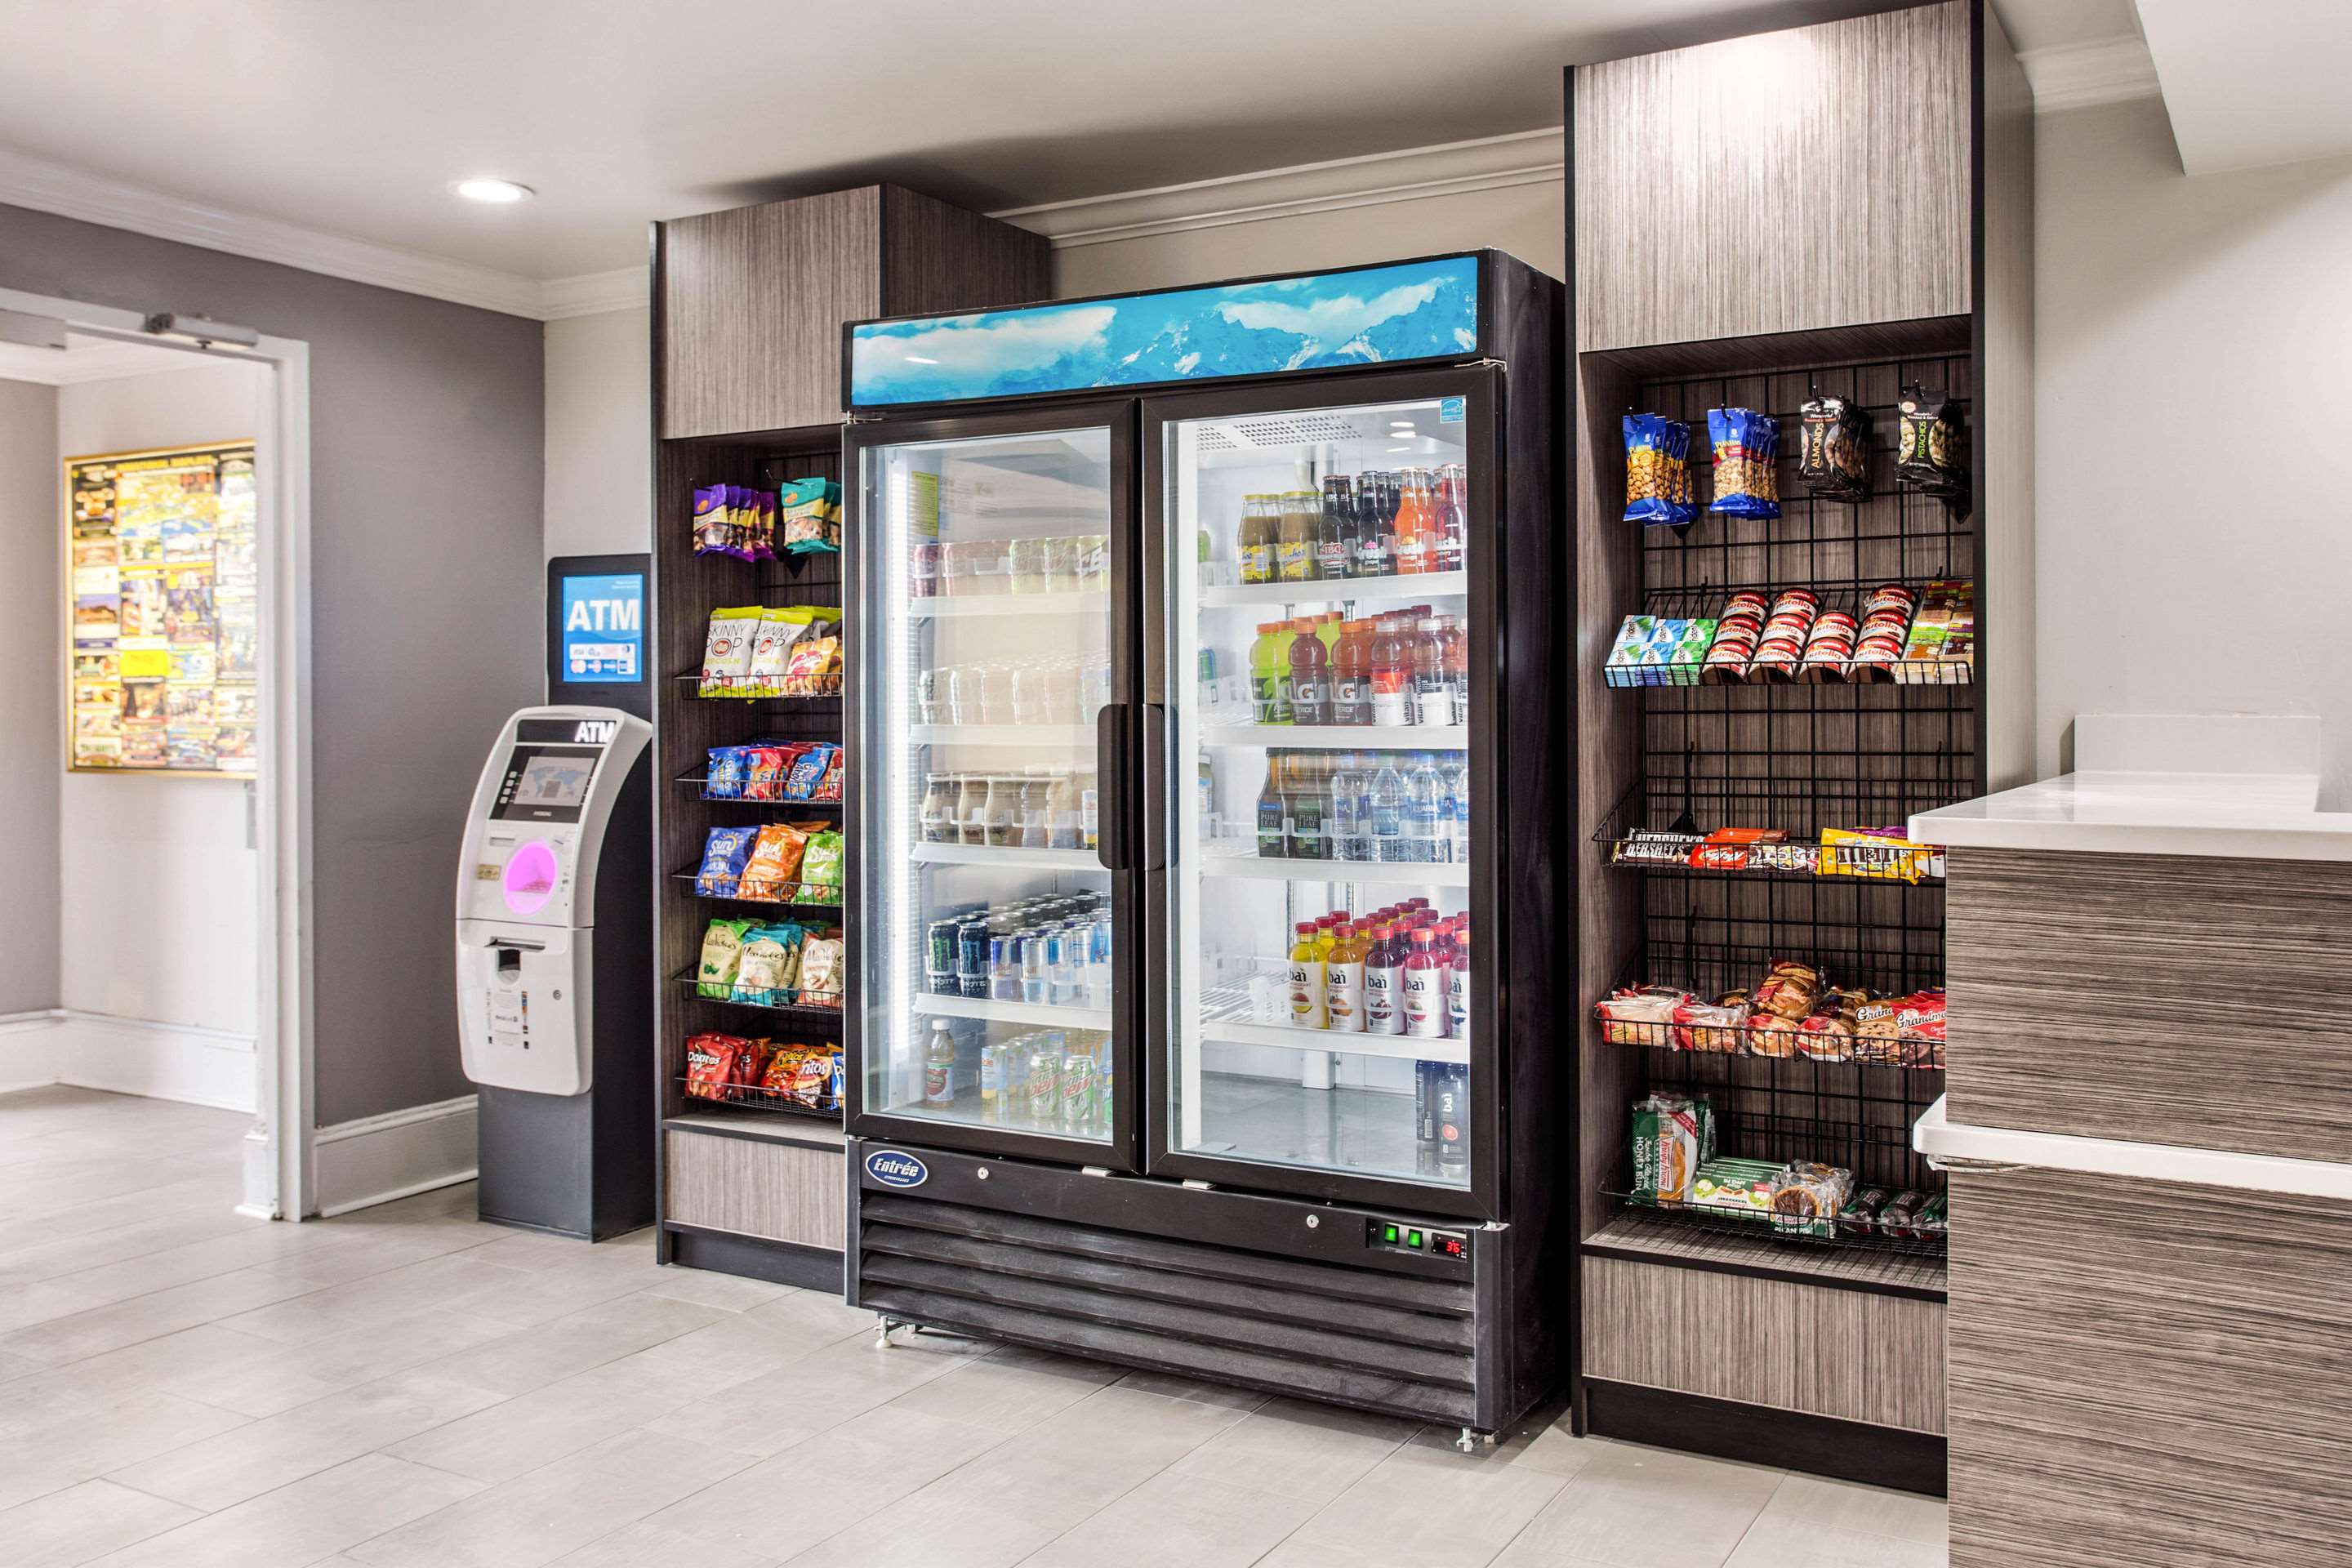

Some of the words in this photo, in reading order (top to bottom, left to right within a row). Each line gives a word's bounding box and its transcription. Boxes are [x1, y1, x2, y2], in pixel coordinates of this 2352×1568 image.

[1811, 422, 1824, 469] ALMONDS
[1918, 421, 1927, 458] PISTACHIOS
[1325, 546, 1342, 555] IBC
[1726, 601, 1759, 612] nutella
[1777, 599, 1811, 610] nutella
[1872, 596, 1906, 606] nutella
[566, 598, 640, 631] ATM
[708, 622, 746, 637] SKINNY
[1626, 620, 1636, 641] Trident
[1718, 626, 1752, 637] nutella
[1863, 621, 1898, 631] nutella
[706, 637, 742, 657] POP
[574, 720, 616, 743] ATM
[1625, 843, 1686, 858] HERSHEY'S
[1290, 968, 1307, 982] bai
[1329, 970, 1347, 984] bai
[1368, 974, 1387, 989] bai
[1406, 977, 1424, 991] bai
[1895, 1010, 1947, 1029] Grandma
[688, 1051, 720, 1065] Doritos
[801, 1059, 827, 1076] ritos
[1441, 1093, 1453, 1111] bai
[1636, 1136, 1644, 1169] HONEY
[874, 1158, 919, 1177] Entrée
[1635, 1171, 1643, 1191] BUN
[1446, 1241, 1461, 1254] 36
